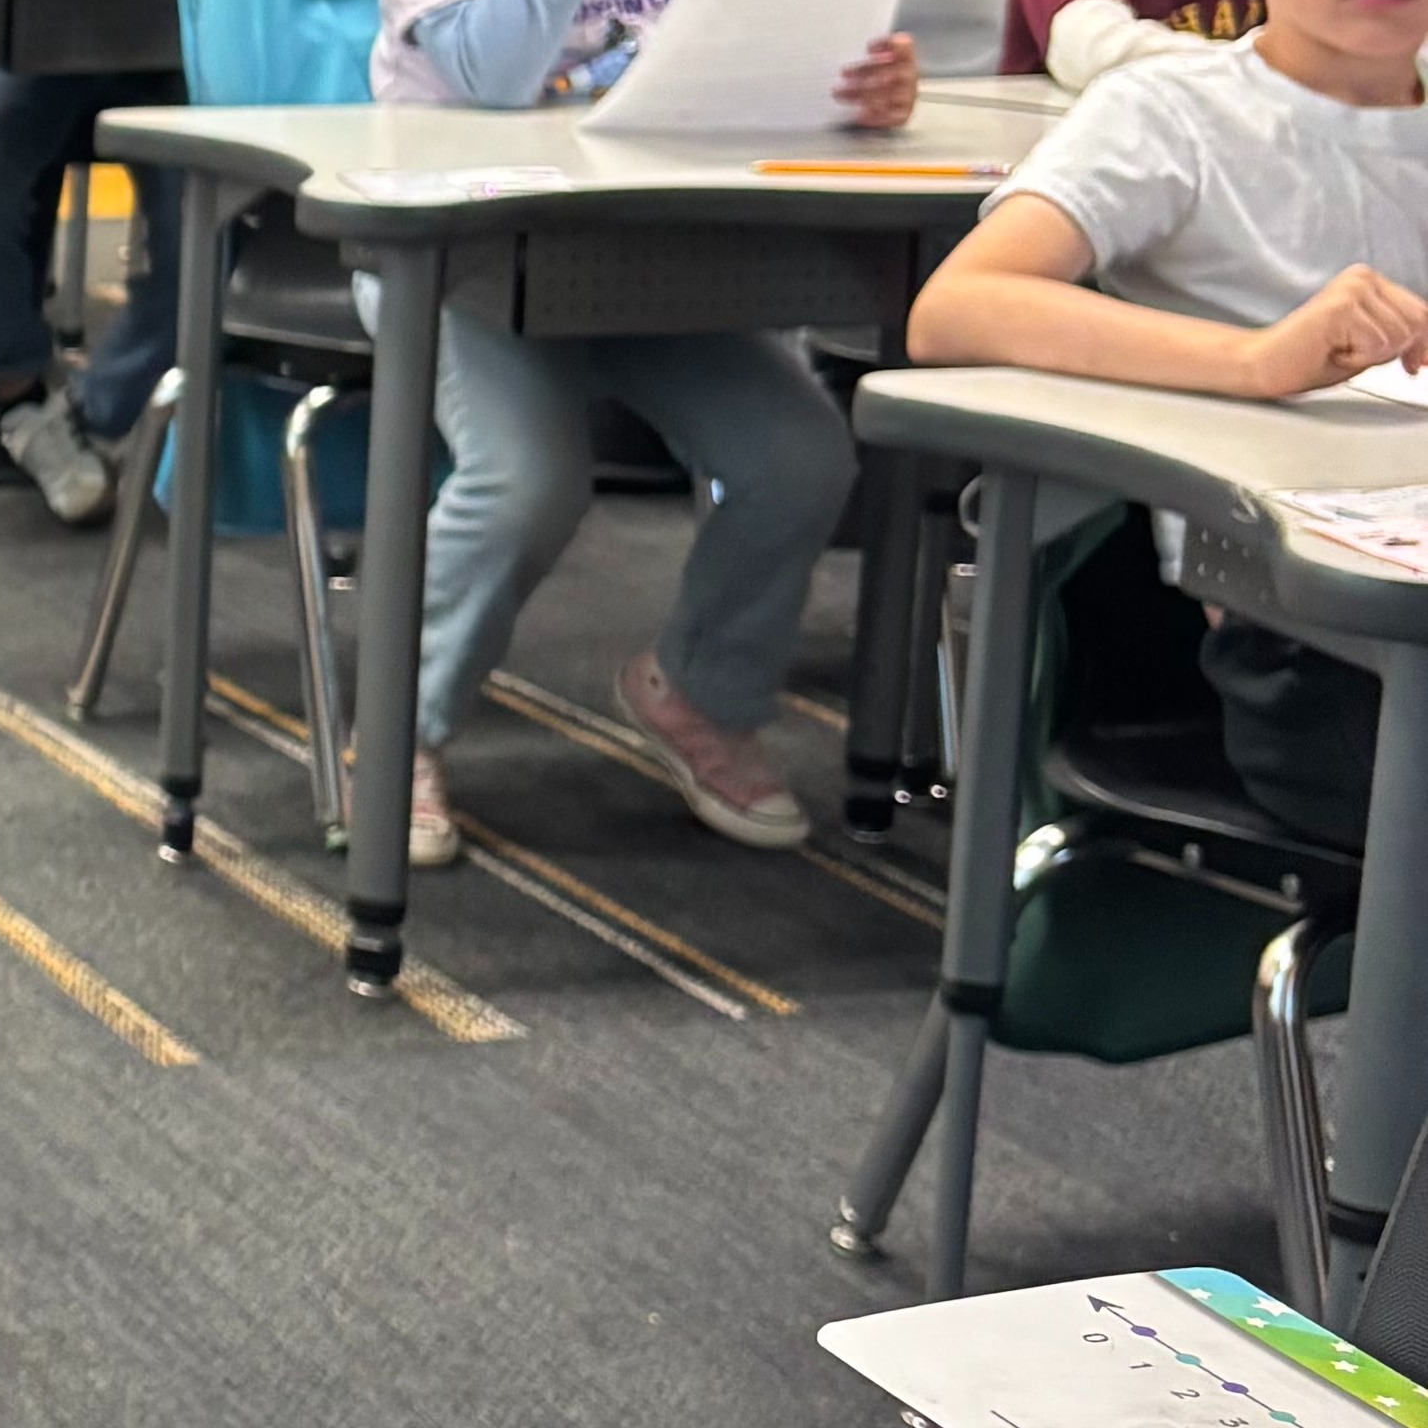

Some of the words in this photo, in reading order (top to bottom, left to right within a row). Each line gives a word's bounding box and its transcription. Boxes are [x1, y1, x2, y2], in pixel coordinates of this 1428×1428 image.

[1082, 1332, 1109, 1344] 0
[1130, 1361, 1155, 1370] 1
[1170, 1388, 1201, 1400] 2
[1219, 1416, 1250, 1428] 3
